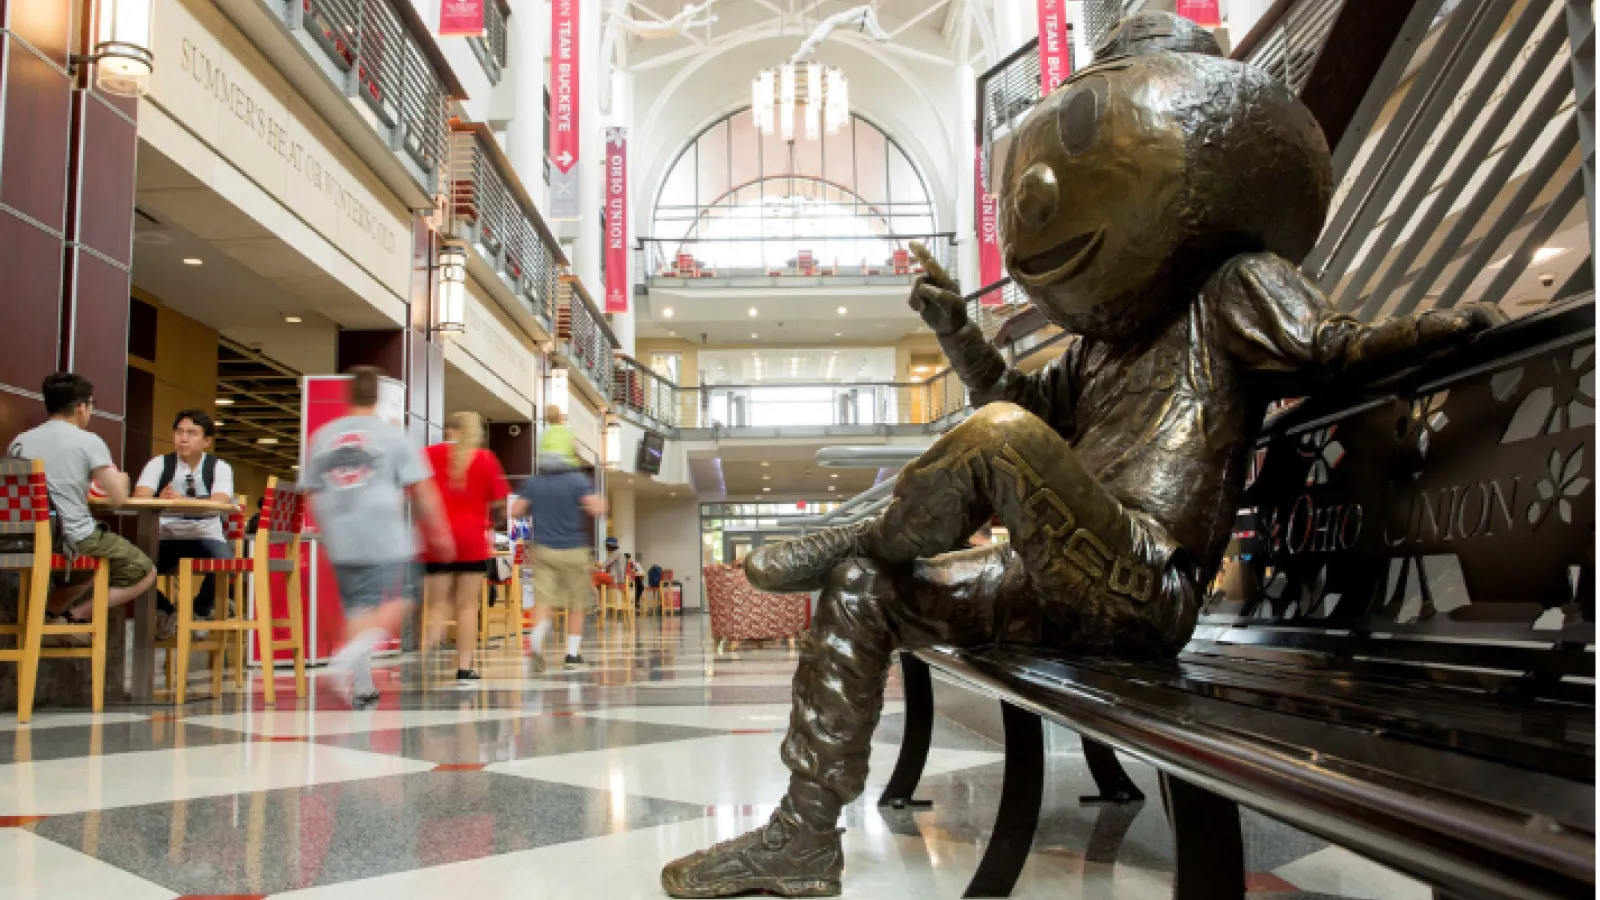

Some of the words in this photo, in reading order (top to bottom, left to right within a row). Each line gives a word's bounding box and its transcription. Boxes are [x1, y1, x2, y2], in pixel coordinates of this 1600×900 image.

[559, 19, 571, 60] TEAM
[1045, 12, 1058, 53] TEAM
[1047, 56, 1060, 91] BUC
[181, 36, 265, 138] SUMMER'S
[266, 116, 304, 172] HEAT
[304, 153, 323, 191] OR
[559, 63, 571, 132] BUCKEYE
[610, 155, 623, 195] OHIO
[610, 198, 623, 249] UNION
[1286, 493, 1363, 554] OHIO
[1384, 469, 1524, 548] UNION
